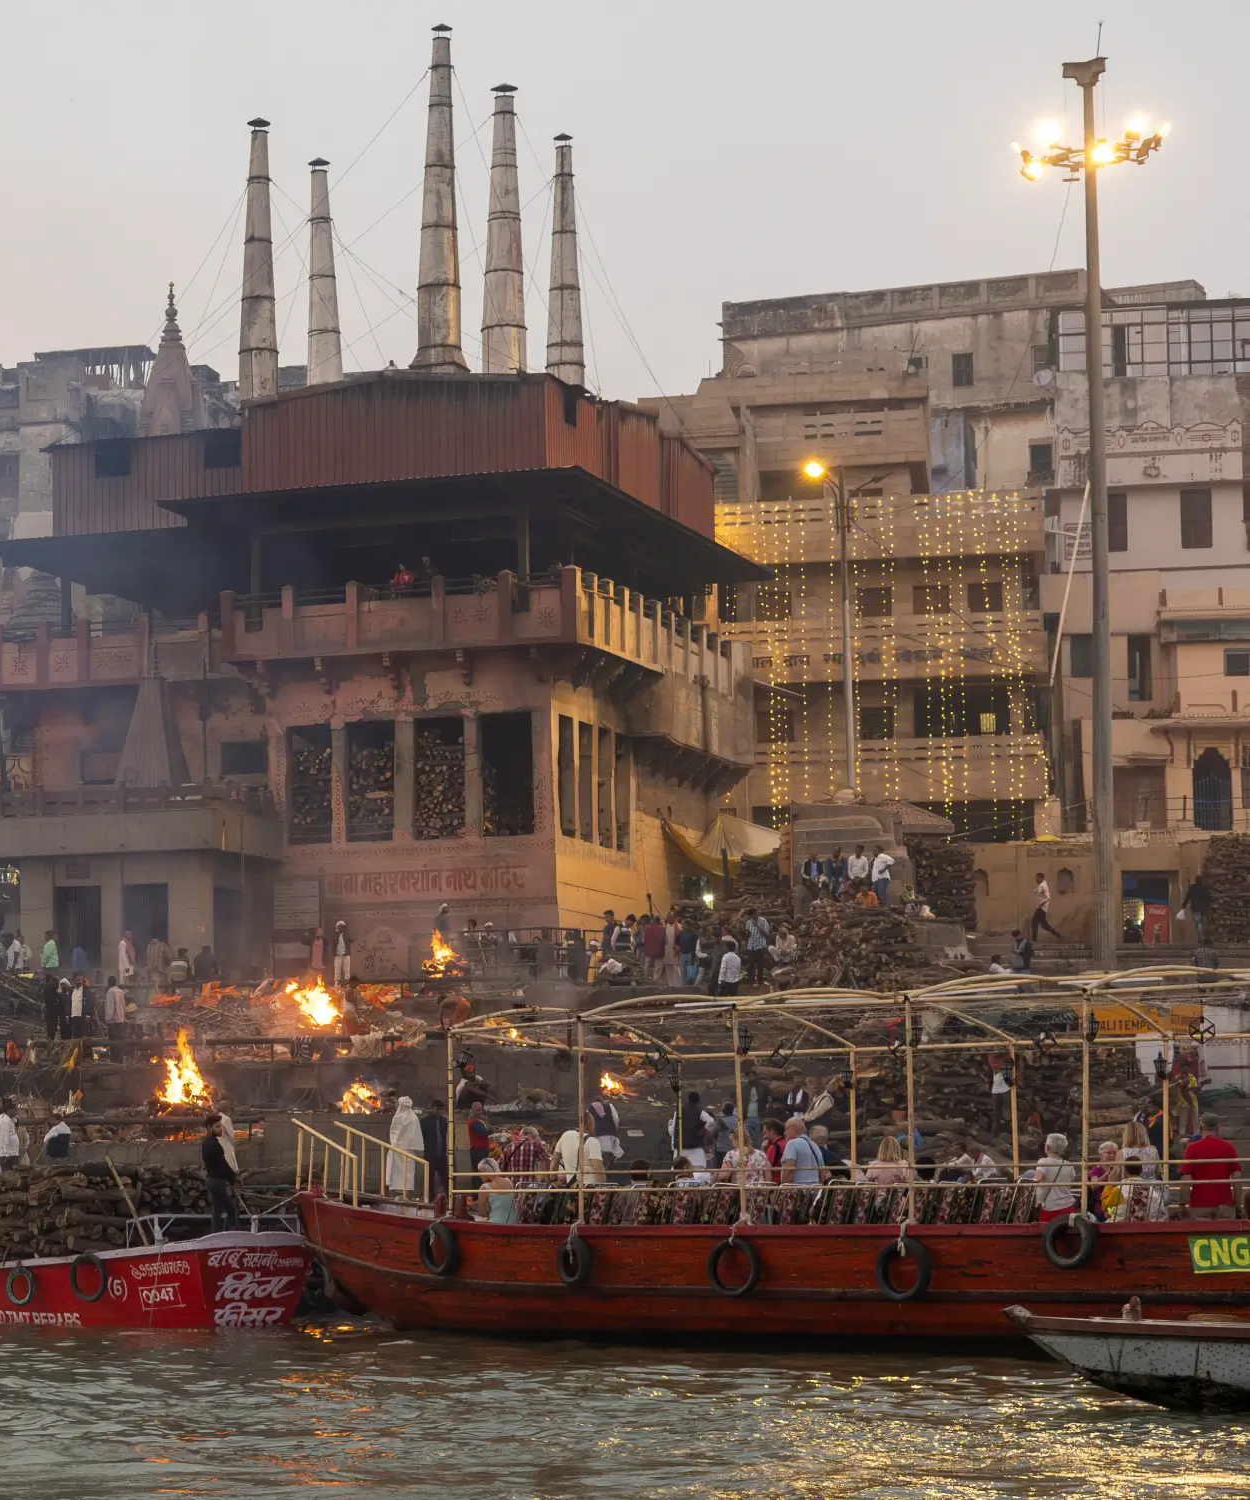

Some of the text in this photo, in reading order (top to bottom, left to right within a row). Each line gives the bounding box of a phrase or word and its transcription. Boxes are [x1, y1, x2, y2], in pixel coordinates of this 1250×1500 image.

[446, 867, 478, 892] नाथ
[208, 1248, 249, 1269] बाबू
[1193, 1237, 1250, 1268] CNG
[142, 1287, 175, 1304] 0047
[215, 1271, 296, 1302] किंग
